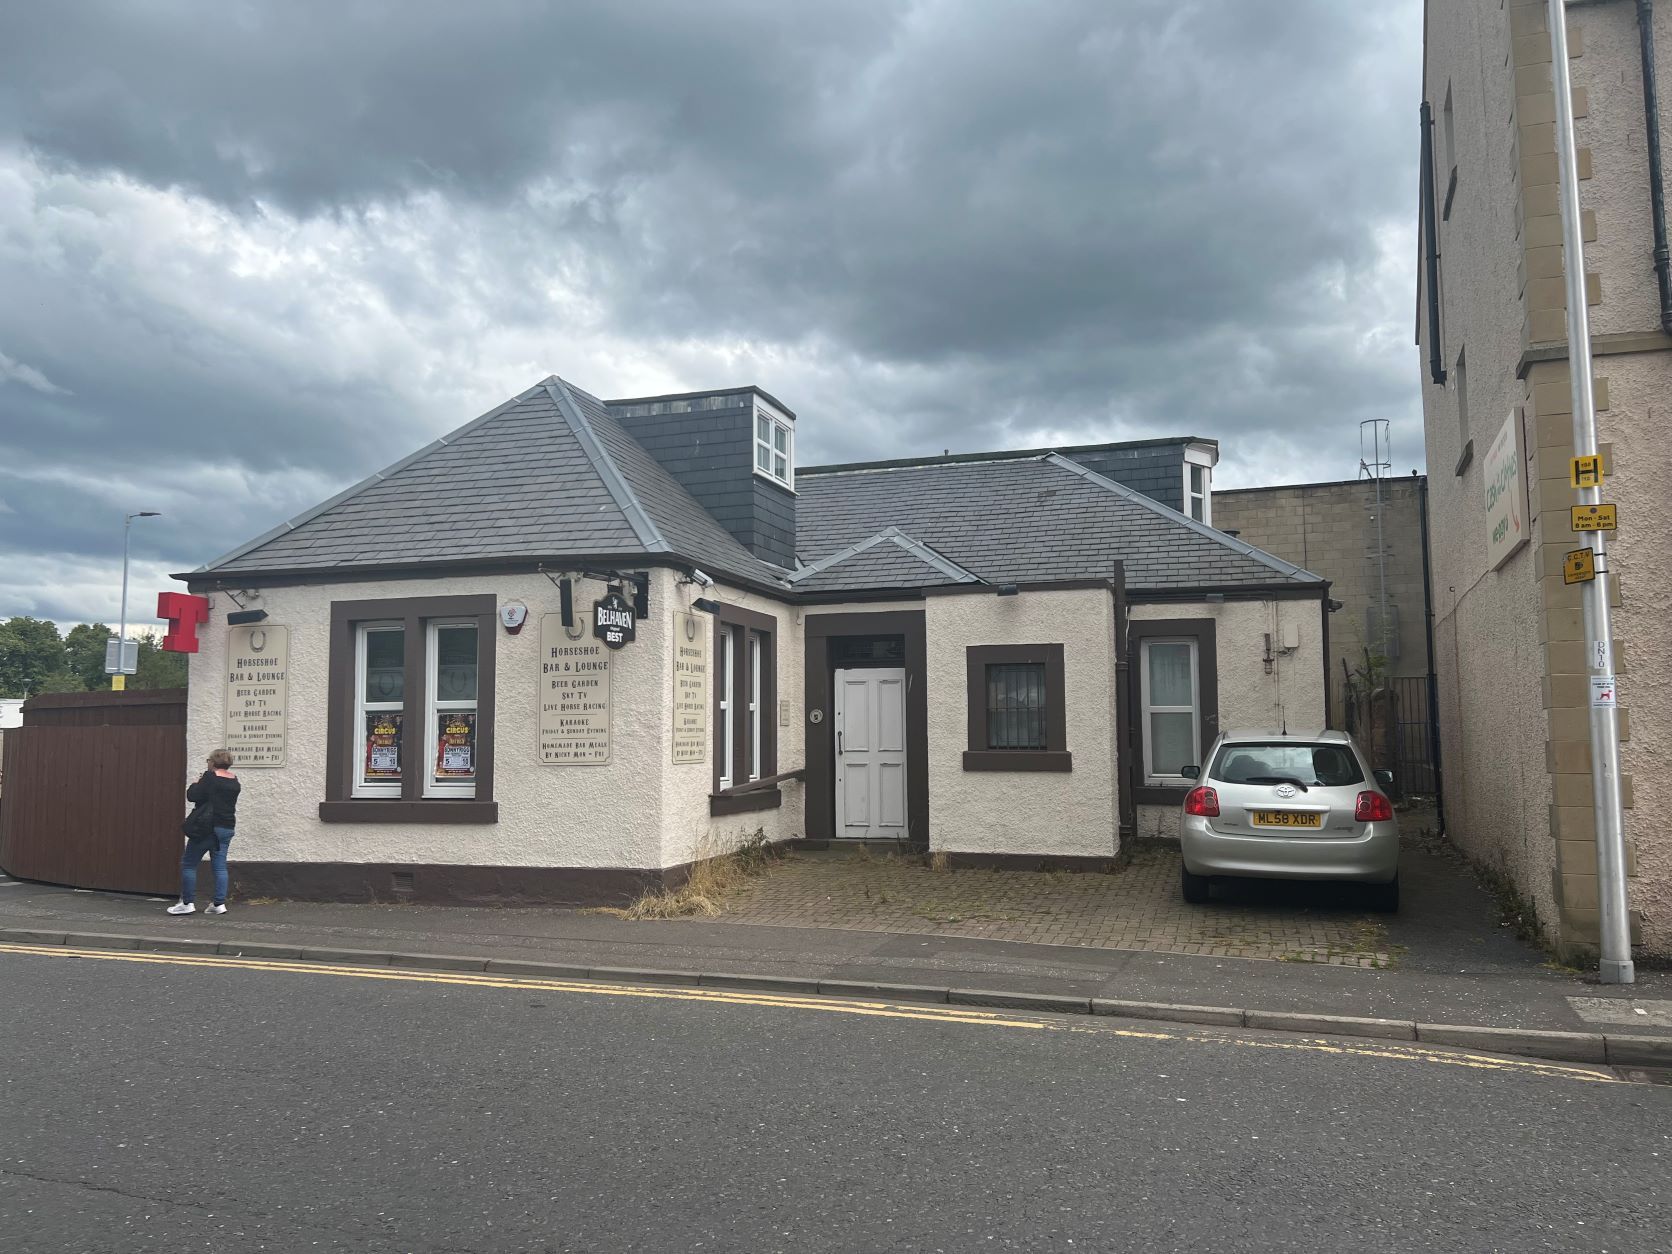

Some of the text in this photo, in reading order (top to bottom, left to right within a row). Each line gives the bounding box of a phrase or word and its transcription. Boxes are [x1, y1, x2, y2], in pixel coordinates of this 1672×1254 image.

[598, 606, 632, 630] BELHAVEN
[606, 631, 624, 642] BEST
[551, 646, 600, 658] HORSESHOE
[237, 658, 278, 668] HORSESHOE
[543, 662, 608, 674] BAR & LOUNGE
[230, 672, 285, 682] BAR & LOUNGE
[552, 680, 598, 689] BEER GARDEN
[577, 692, 588, 700] TV
[544, 704, 558, 712] LIVE
[560, 719, 590, 727] KARAOKE
[1258, 814, 1316, 824] ML58 XDR
